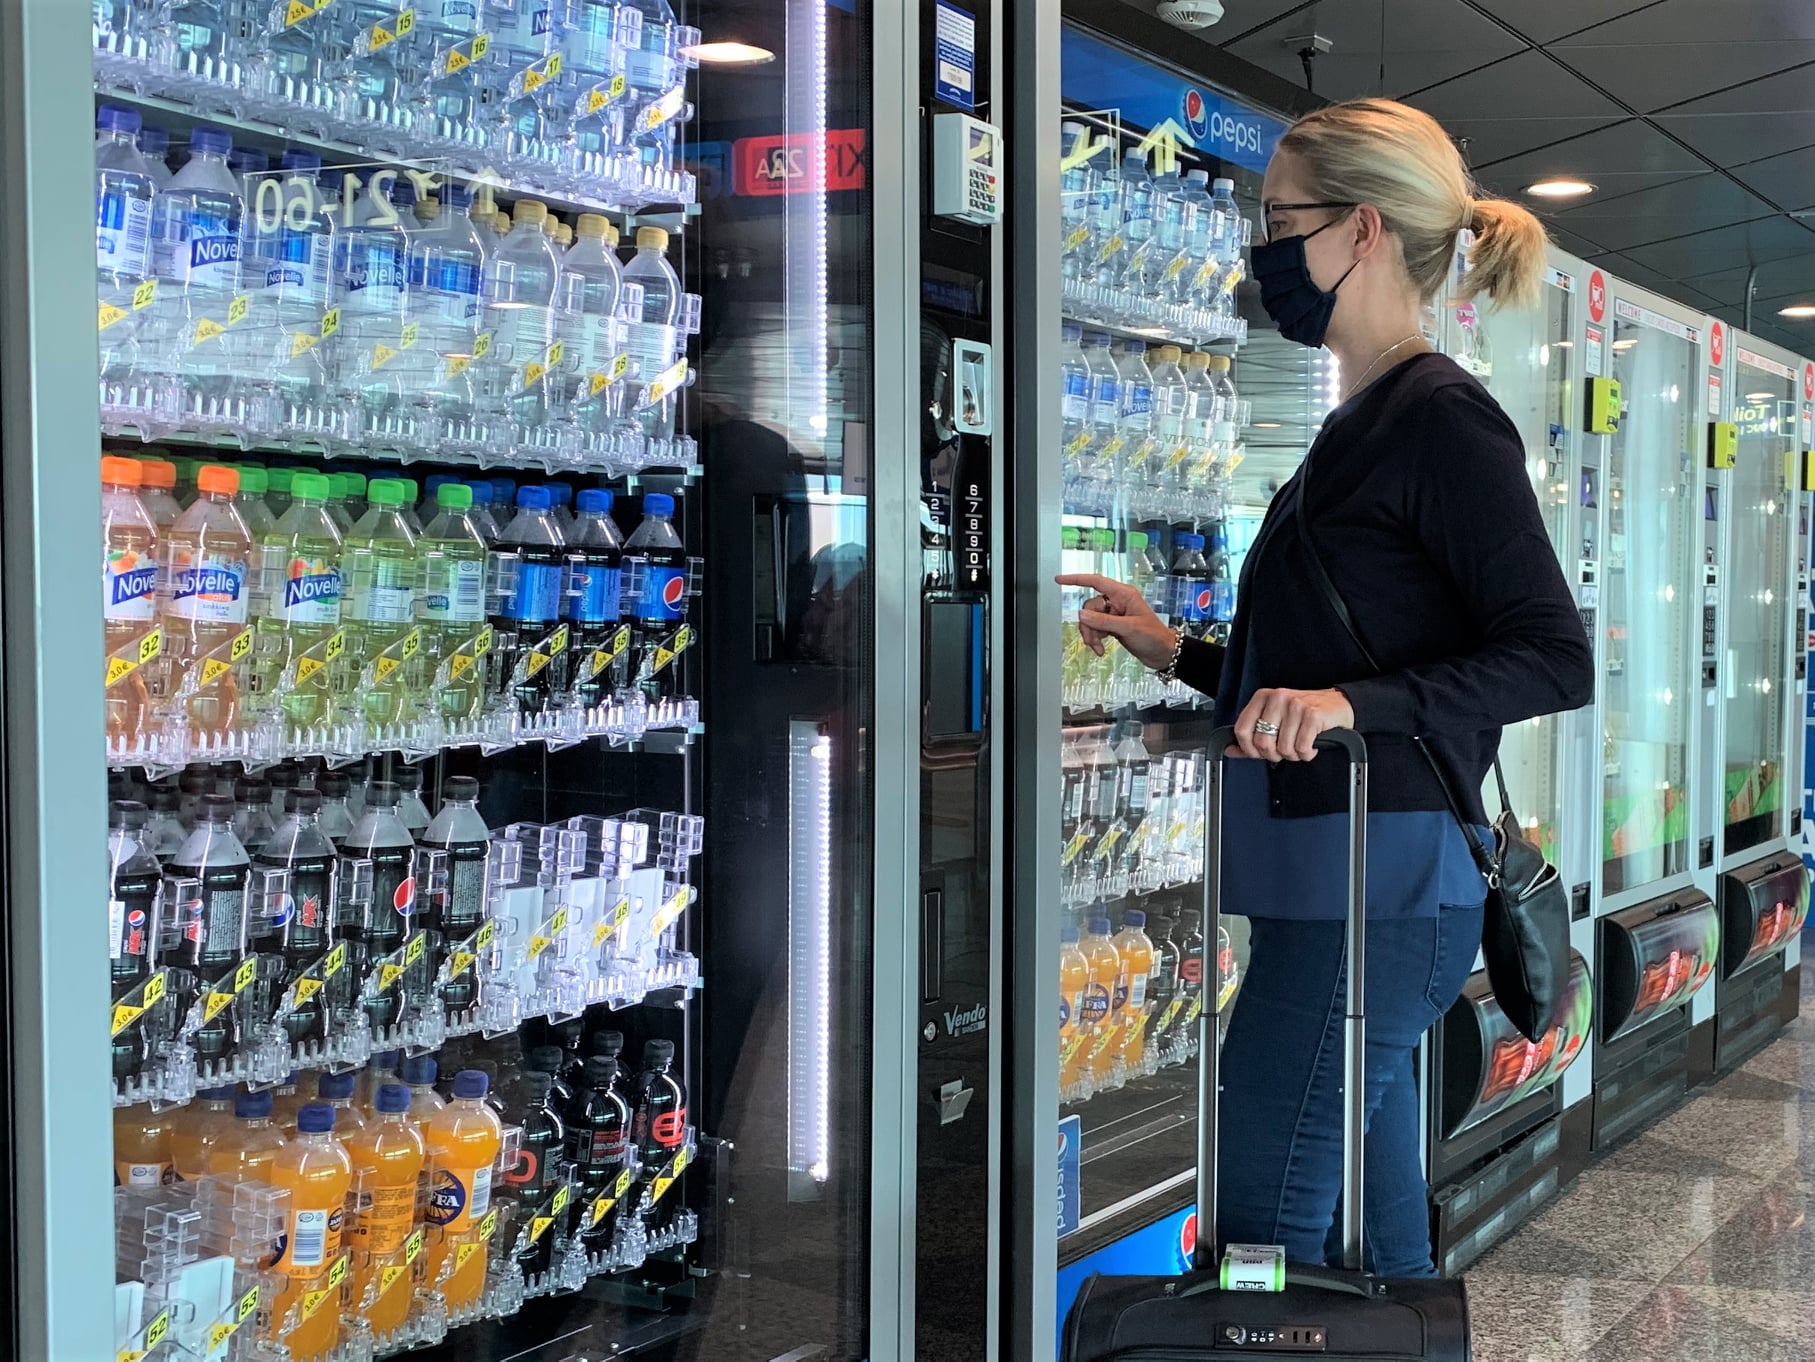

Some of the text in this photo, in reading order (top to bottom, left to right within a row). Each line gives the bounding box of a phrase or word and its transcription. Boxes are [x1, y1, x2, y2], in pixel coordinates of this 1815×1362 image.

[398, 15, 412, 30] 15
[474, 40, 486, 55] 16
[548, 58, 559, 74] 17
[611, 77, 623, 92] 18
[1211, 111, 1262, 154] pepsi
[135, 284, 154, 306] 22
[230, 300, 247, 321] 23
[322, 315, 338, 334] 24
[475, 337, 489, 354] 26
[549, 346, 561, 363] 27
[614, 358, 626, 374] 28
[931, 480, 938, 493] 1
[970, 484, 978, 497] 6
[931, 498, 939, 510] 2
[970, 502, 978, 513] 7
[970, 518, 978, 530] 8
[931, 533, 939, 545] 4
[970, 535, 978, 548] 9
[970, 552, 978, 565] 0
[141, 634, 159, 659] 32
[233, 634, 251, 657] 33
[327, 636, 343, 657] 34
[403, 635, 418, 655] 35
[476, 633, 490, 653] 36
[551, 632, 565, 652] 37
[614, 632, 627, 652] 38
[675, 631, 687, 650] 39
[552, 912, 566, 931] 47
[615, 902, 628, 921] 48
[478, 926, 492, 945] 46
[406, 939, 422, 959] 45
[328, 952, 343, 972] 44
[236, 964, 254, 987] 43
[144, 979, 162, 1003] 42
[943, 1002, 986, 1036] Vendo
[674, 1153, 686, 1173] 59
[616, 1174, 629, 1194] 58
[552, 1190, 567, 1212] 57
[1057, 1166, 1067, 1231] pepsi
[480, 1214, 495, 1237] 56
[406, 1234, 421, 1259] 55
[330, 1265, 345, 1287] 54
[240, 1292, 257, 1317] 53
[148, 1315, 168, 1345] 52
